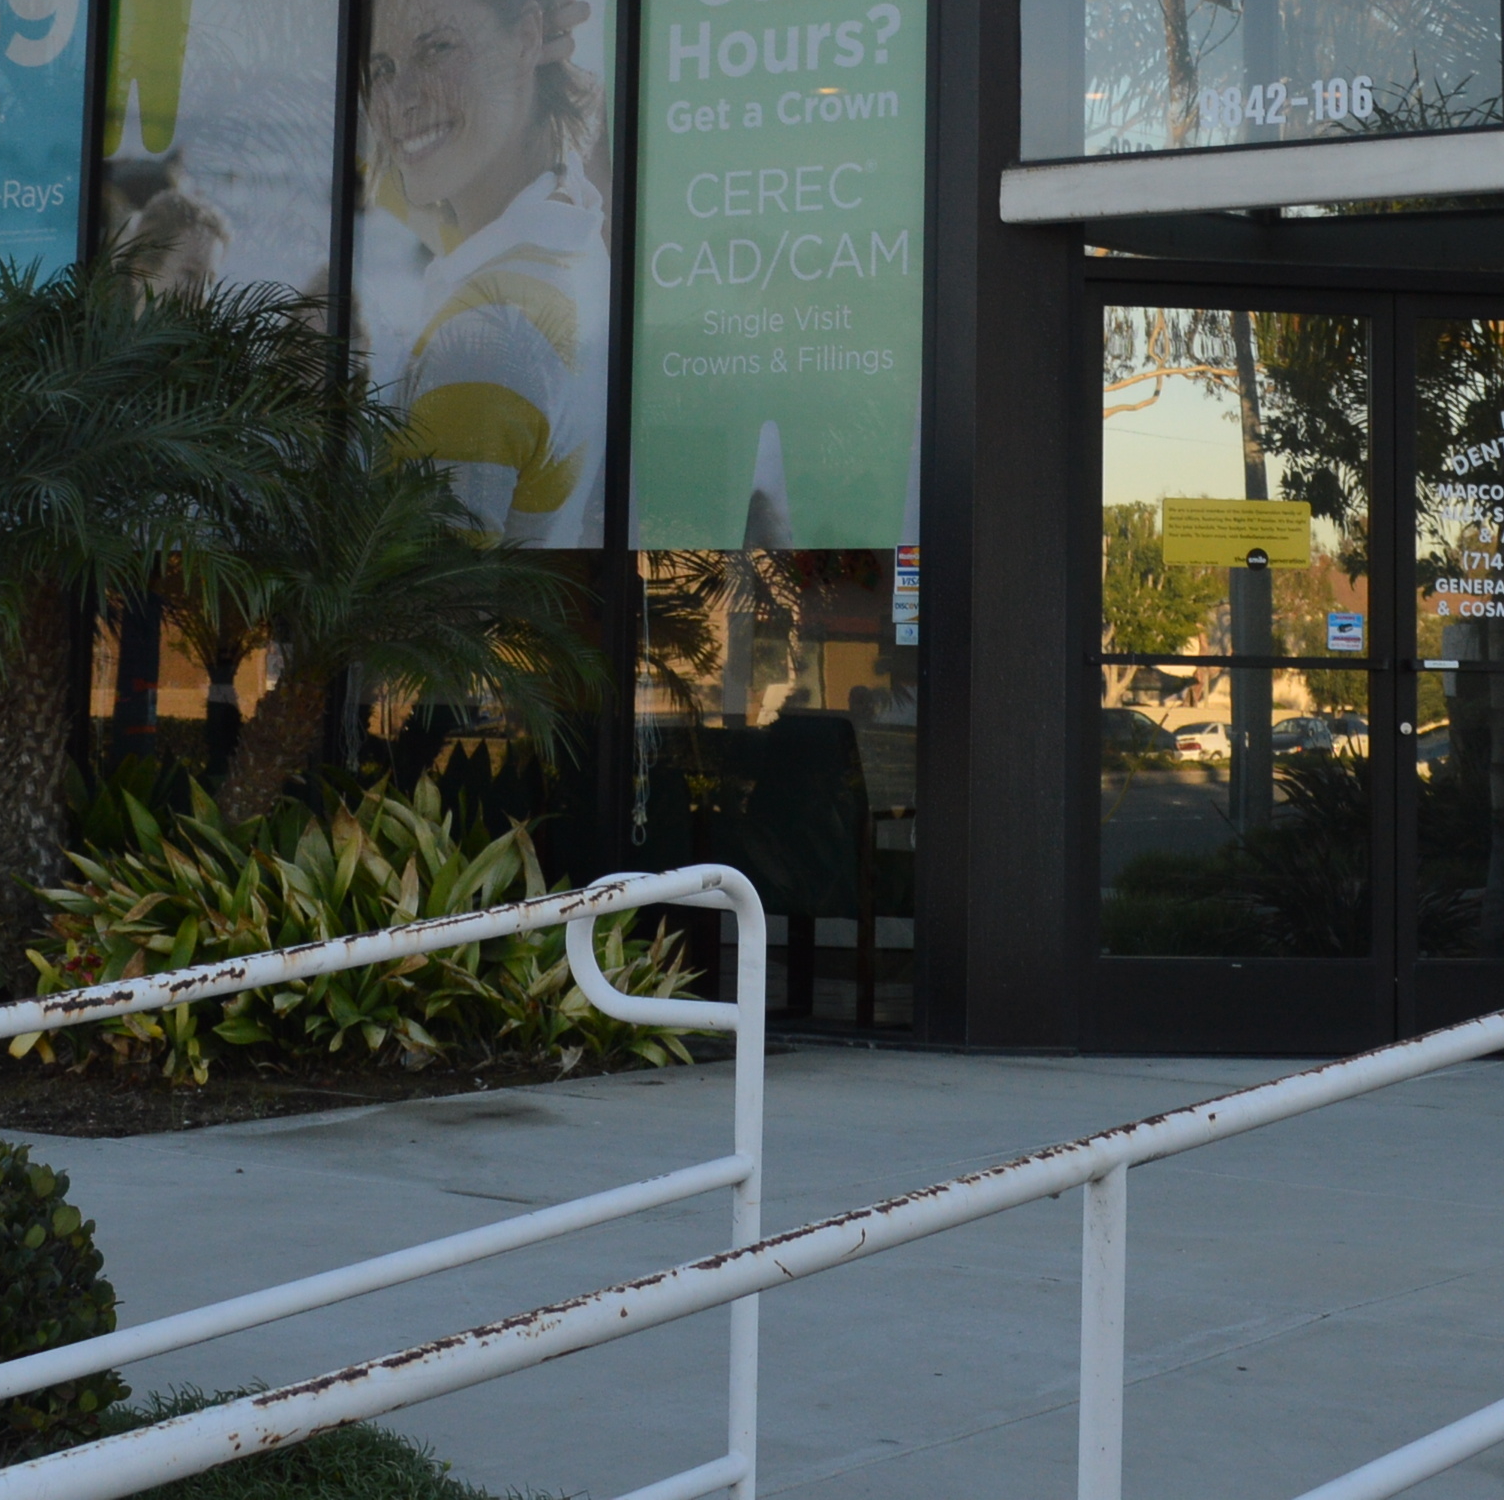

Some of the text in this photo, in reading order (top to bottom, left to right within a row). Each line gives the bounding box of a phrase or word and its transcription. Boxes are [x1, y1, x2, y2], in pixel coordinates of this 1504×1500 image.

[668, 3, 903, 83] Hours?
[667, 89, 899, 134] Get a Crown
[1199, 75, 1374, 129] 9842-106
[651, 229, 910, 291] CAD/CAM
[703, 304, 853, 339] Single Visit
[662, 345, 895, 378] Crowns & Fillings
[1479, 527, 1493, 543] &
[1437, 601, 1451, 617] &
